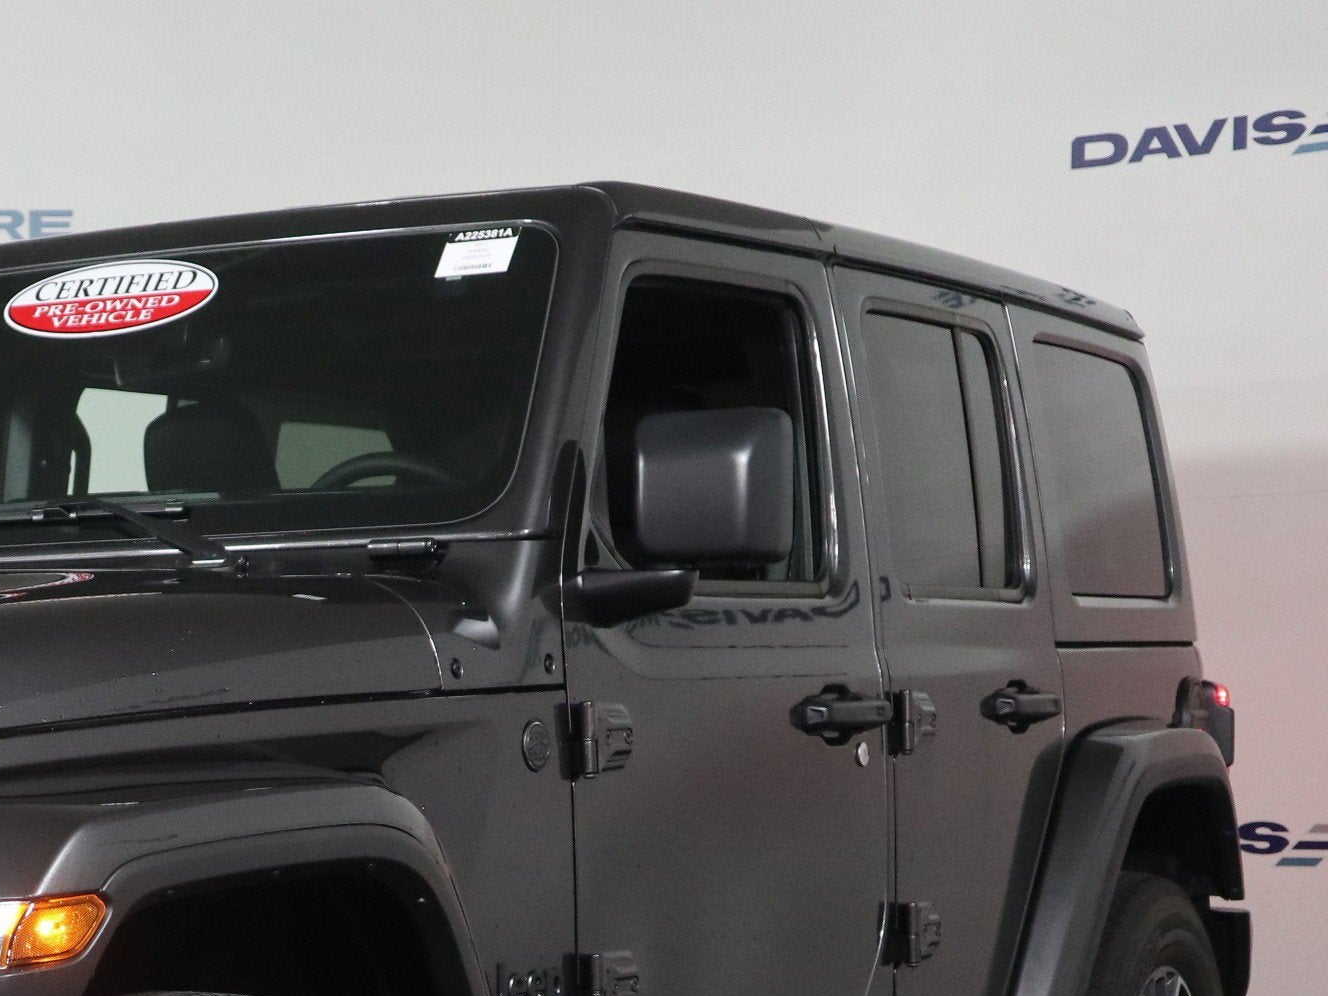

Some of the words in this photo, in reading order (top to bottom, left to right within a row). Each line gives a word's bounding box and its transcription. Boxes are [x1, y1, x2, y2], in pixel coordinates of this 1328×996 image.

[1071, 110, 1307, 170] DAVIS
[35, 269, 198, 303] CERTIFIED
[33, 294, 181, 319] PRE-OWNED
[51, 308, 155, 328] VEHICLE
